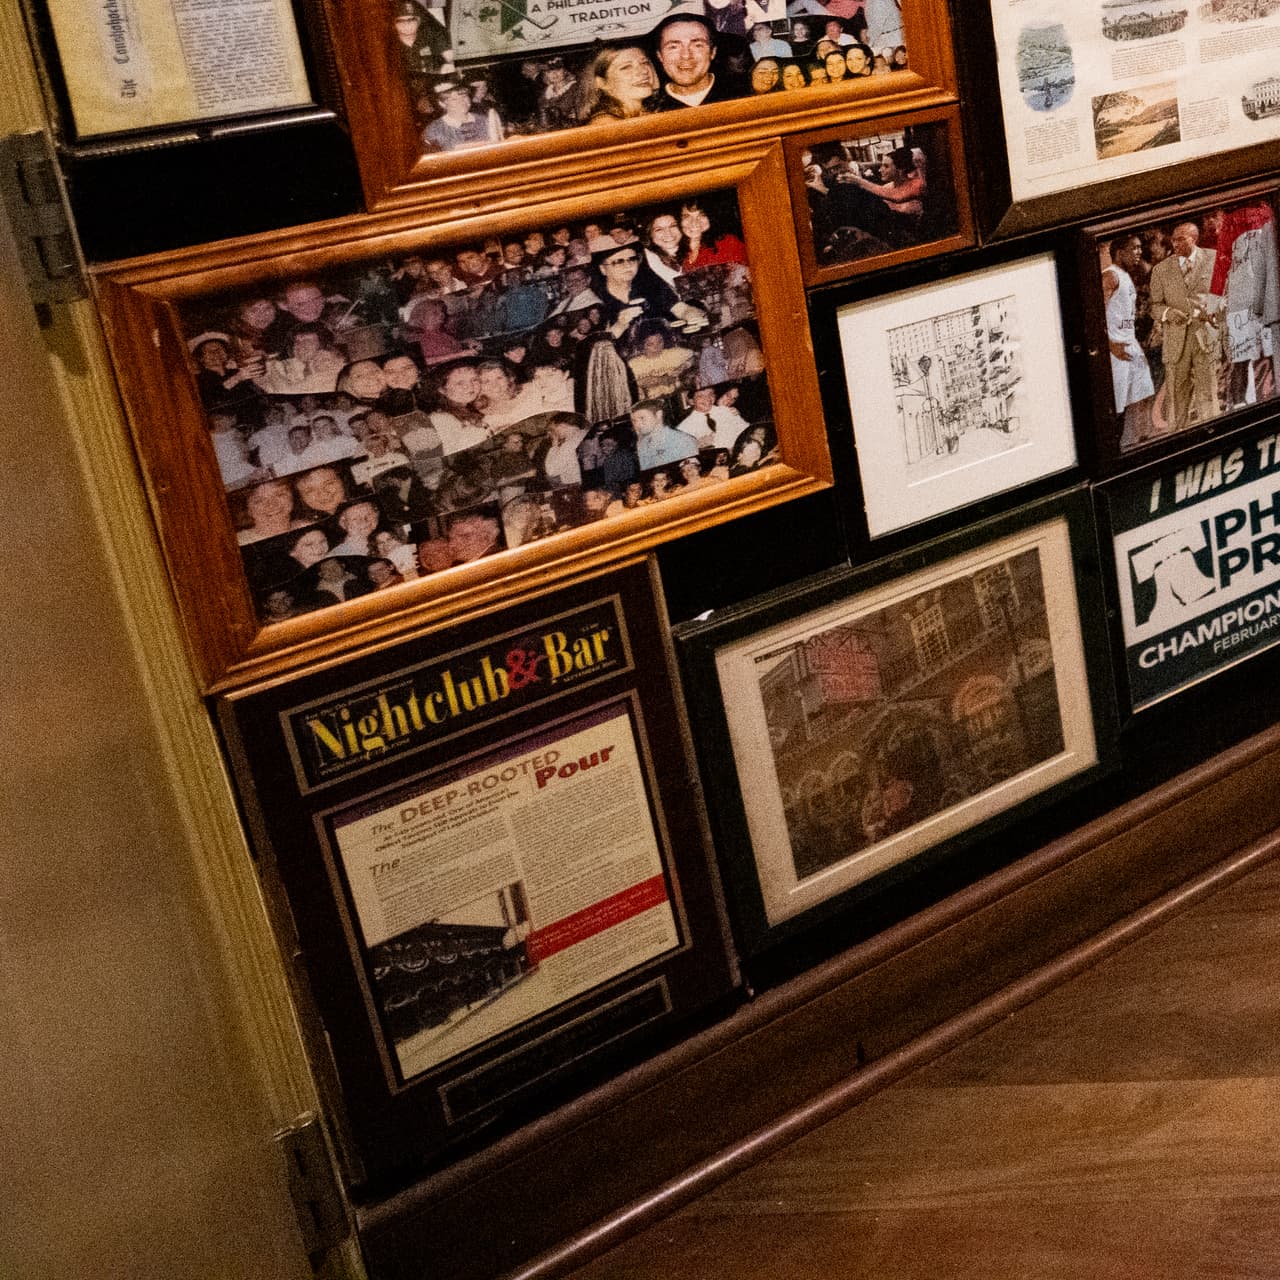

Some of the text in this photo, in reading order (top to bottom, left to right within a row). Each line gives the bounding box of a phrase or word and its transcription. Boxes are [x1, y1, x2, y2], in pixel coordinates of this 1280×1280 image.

[530, 3, 542, 14] A
[569, 2, 651, 25] TRADITION
[1150, 478, 1162, 513] I
[1174, 447, 1245, 504] WAS
[306, 656, 512, 769] Nightclub
[542, 628, 610, 684] Bar
[371, 744, 616, 836] The DEEP-ROOTED Pour
[370, 857, 401, 876] The
